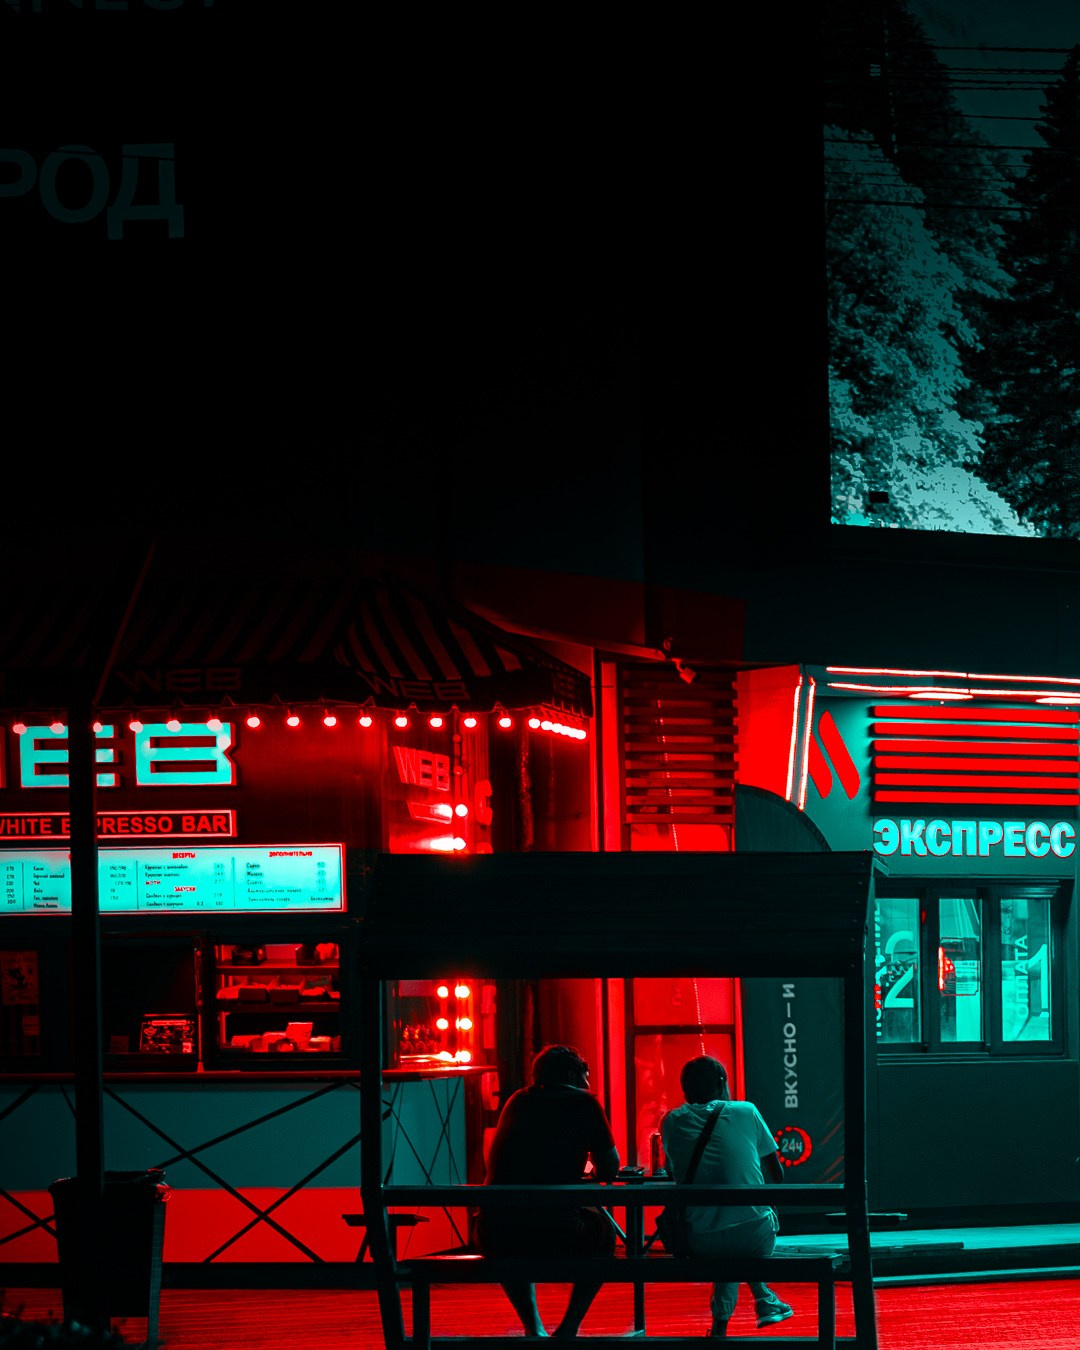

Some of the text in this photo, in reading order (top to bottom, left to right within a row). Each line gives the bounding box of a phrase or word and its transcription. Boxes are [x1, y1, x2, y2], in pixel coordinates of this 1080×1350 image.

[115, 666, 243, 694] WEB
[356, 668, 471, 703] WEB
[393, 745, 450, 792] WEB
[62, 816, 173, 834] ERESSO
[181, 815, 228, 833] BAR
[873, 818, 1077, 858] ЭКСПРЕСС
[1013, 934, 1029, 1018] ОПЛАТА
[783, 1022, 799, 1109] ВКУСНО
